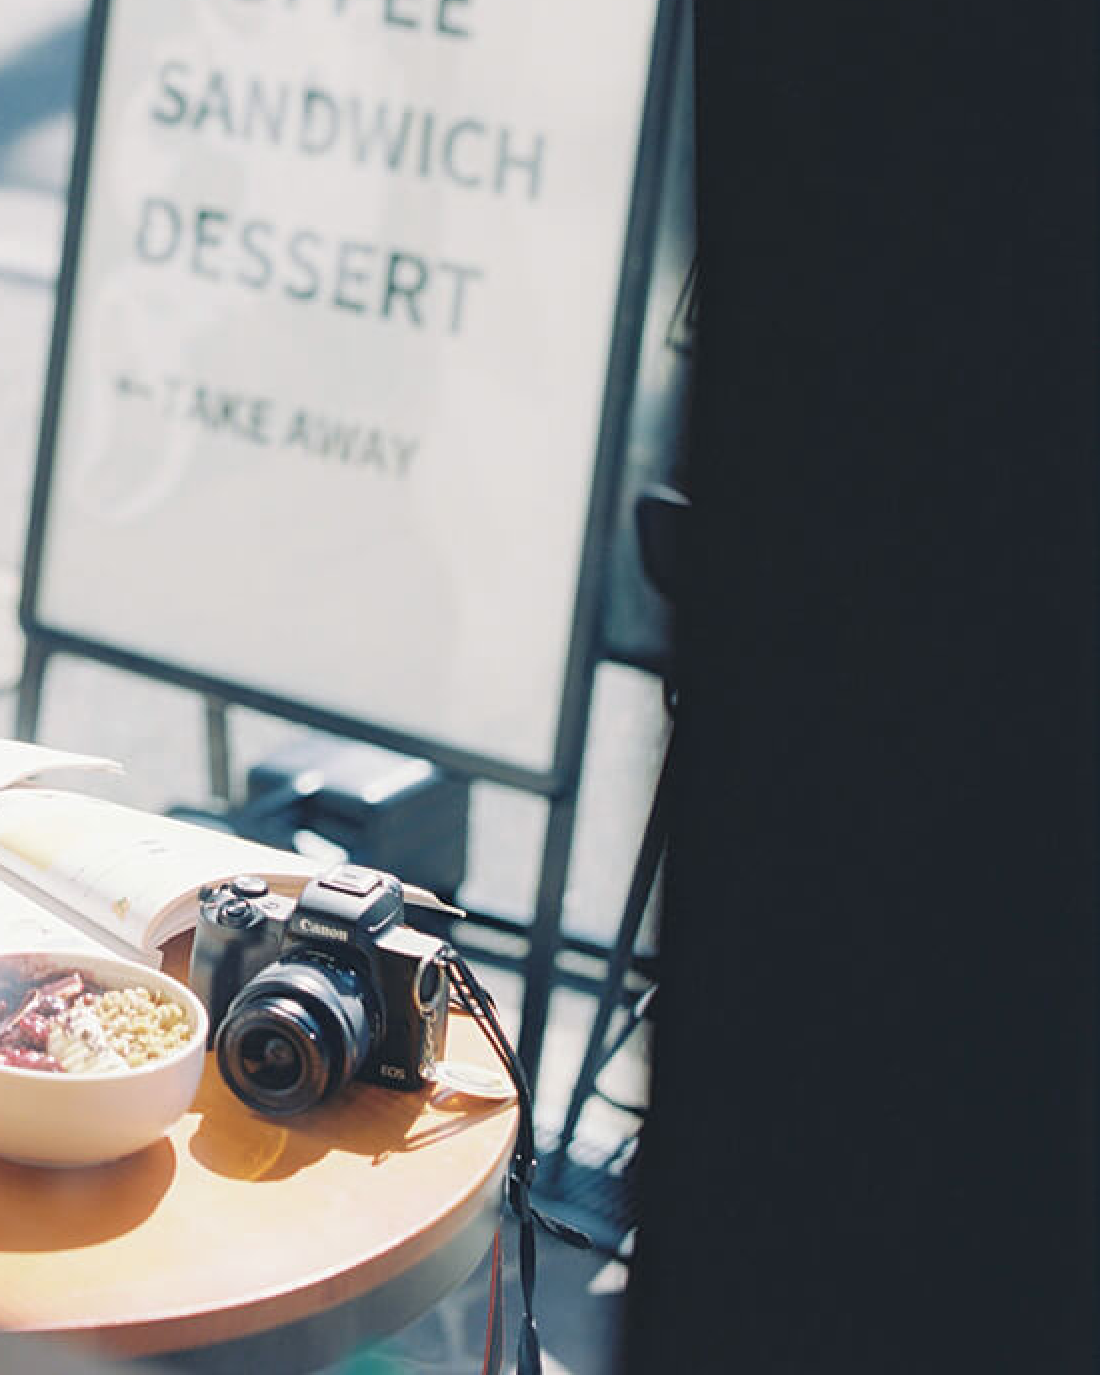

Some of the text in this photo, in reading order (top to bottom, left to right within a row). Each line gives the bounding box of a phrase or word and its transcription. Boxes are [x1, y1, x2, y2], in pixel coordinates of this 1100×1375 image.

[151, 61, 548, 202] SANDWICH
[135, 198, 485, 335] DESSERT
[164, 376, 421, 481] TAKE AWAY
[300, 918, 349, 943] Canon
[381, 1064, 406, 1080] EOS
